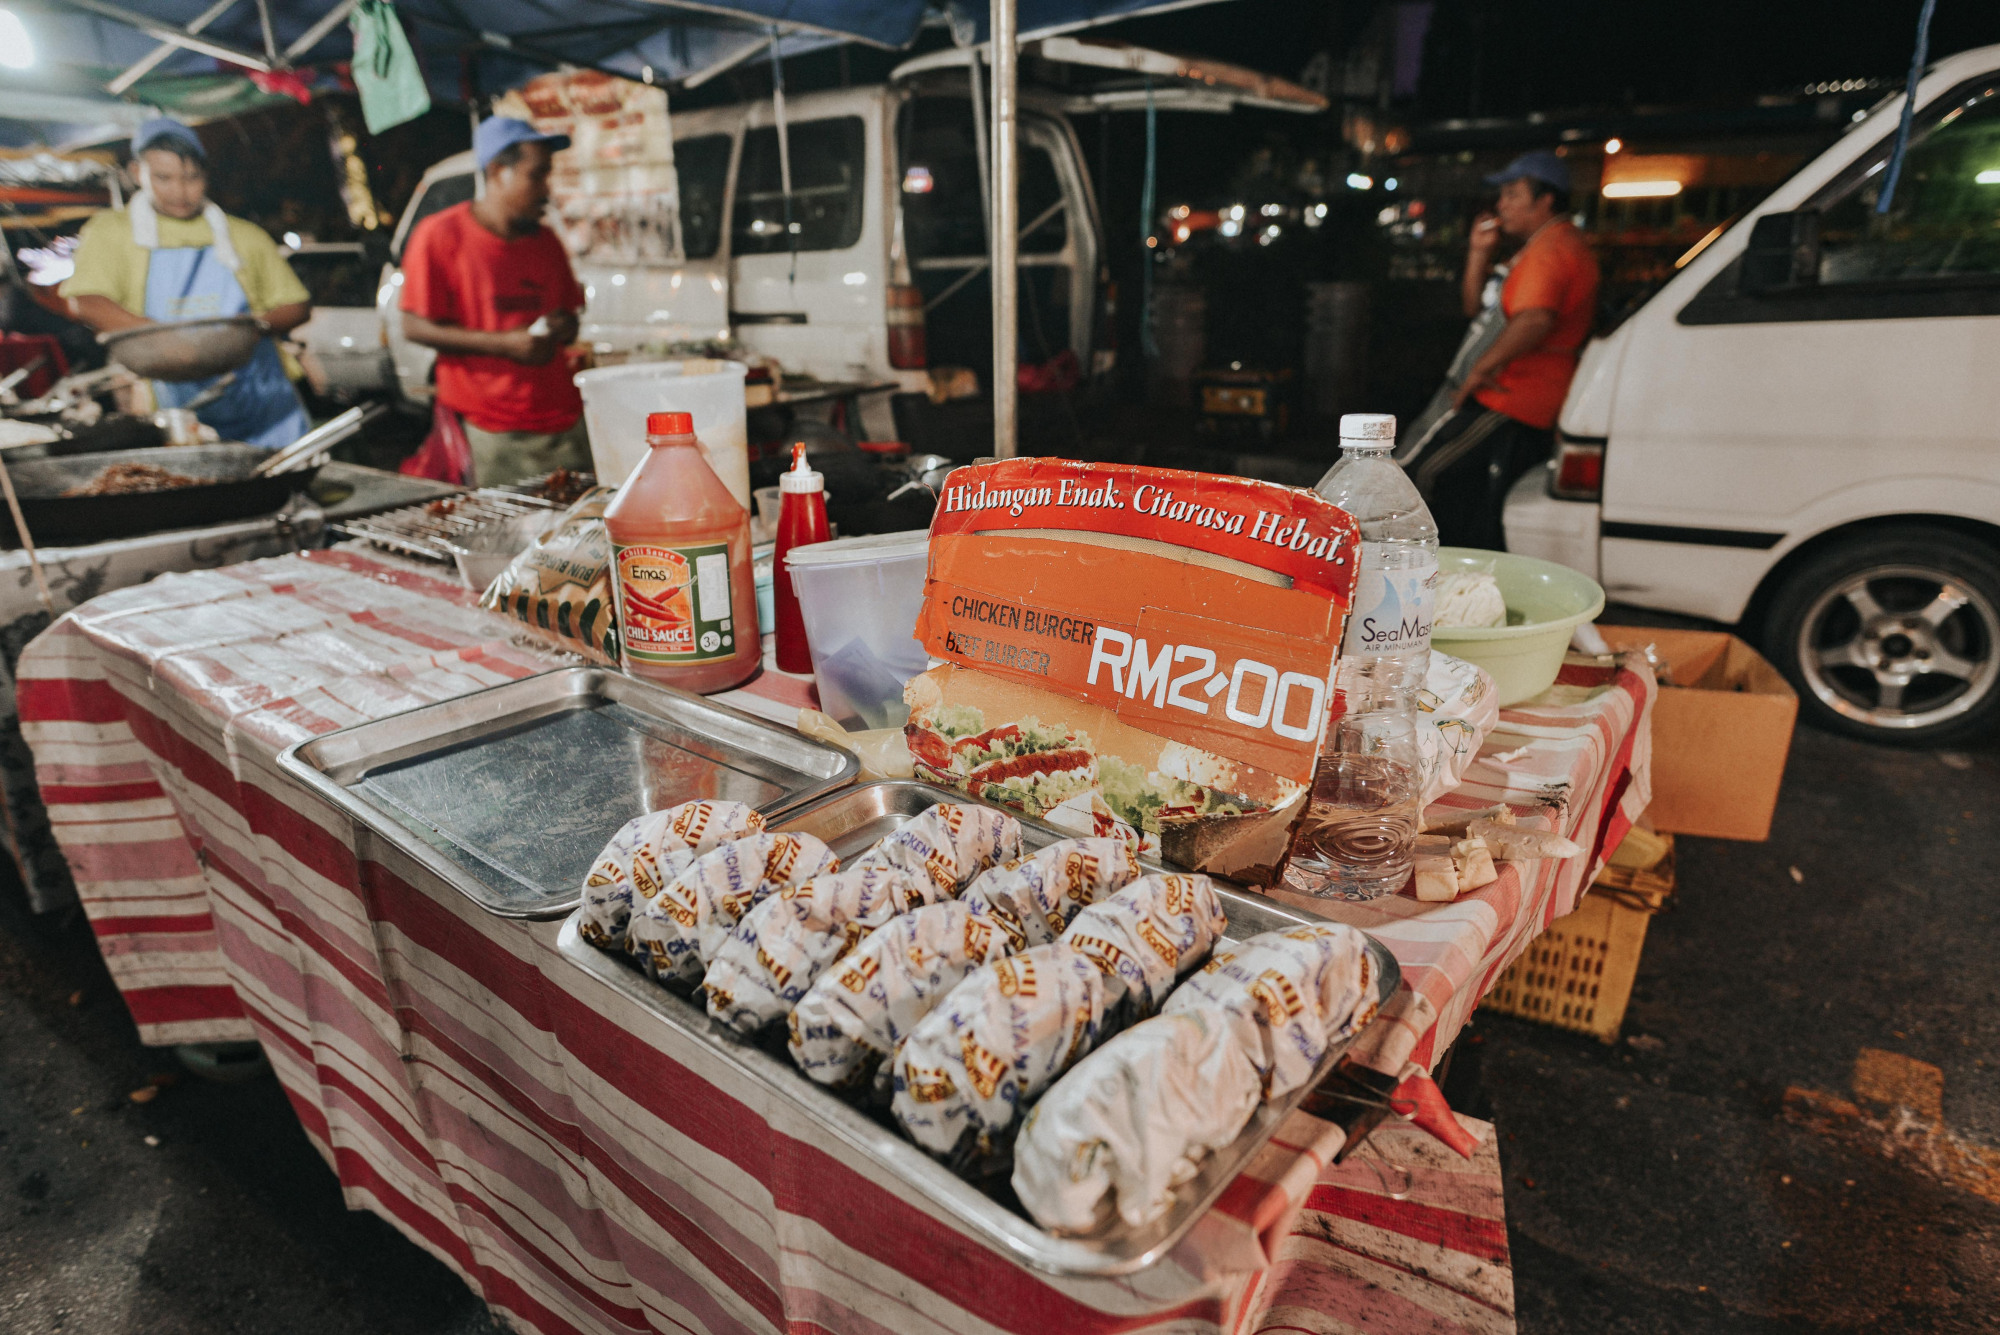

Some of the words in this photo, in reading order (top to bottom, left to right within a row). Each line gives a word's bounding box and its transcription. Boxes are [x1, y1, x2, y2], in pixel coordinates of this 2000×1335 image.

[944, 481, 1052, 517] Hidangan
[1055, 477, 1126, 510] Enak.
[1132, 484, 1247, 536] Citarasa
[1248, 509, 1346, 566] Hebat.
[631, 565, 667, 581] Emas
[626, 625, 649, 642] CHILI
[652, 628, 691, 643] SAUCE
[952, 595, 1021, 630] CHICKEN
[1023, 609, 1094, 646] BURGER
[945, 631, 981, 658] BEEF
[983, 640, 1051, 676] BURGER
[1364, 643, 1381, 653] AIR
[1383, 640, 1424, 652] MINUMAN
